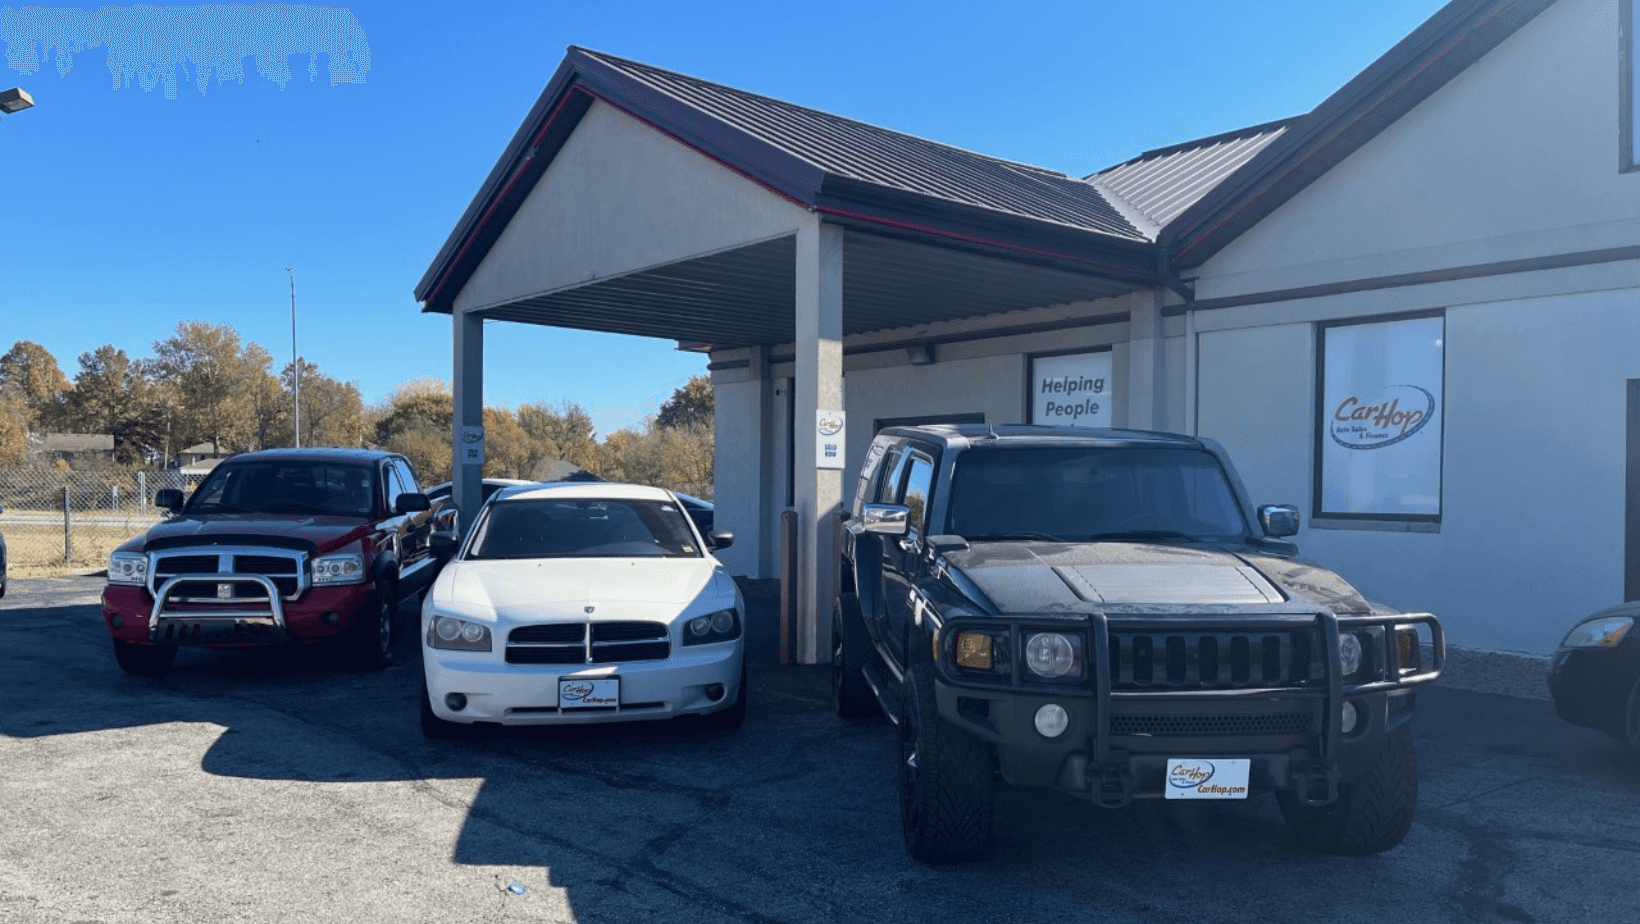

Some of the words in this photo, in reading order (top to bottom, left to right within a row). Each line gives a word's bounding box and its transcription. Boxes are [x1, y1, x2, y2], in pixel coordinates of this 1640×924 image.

[1041, 376, 1104, 396] Helping
[1045, 399, 1099, 419] People
[1334, 396, 1423, 437] CarHop
[1171, 764, 1210, 780] CarHop
[1197, 785, 1246, 794] CarHop.com
